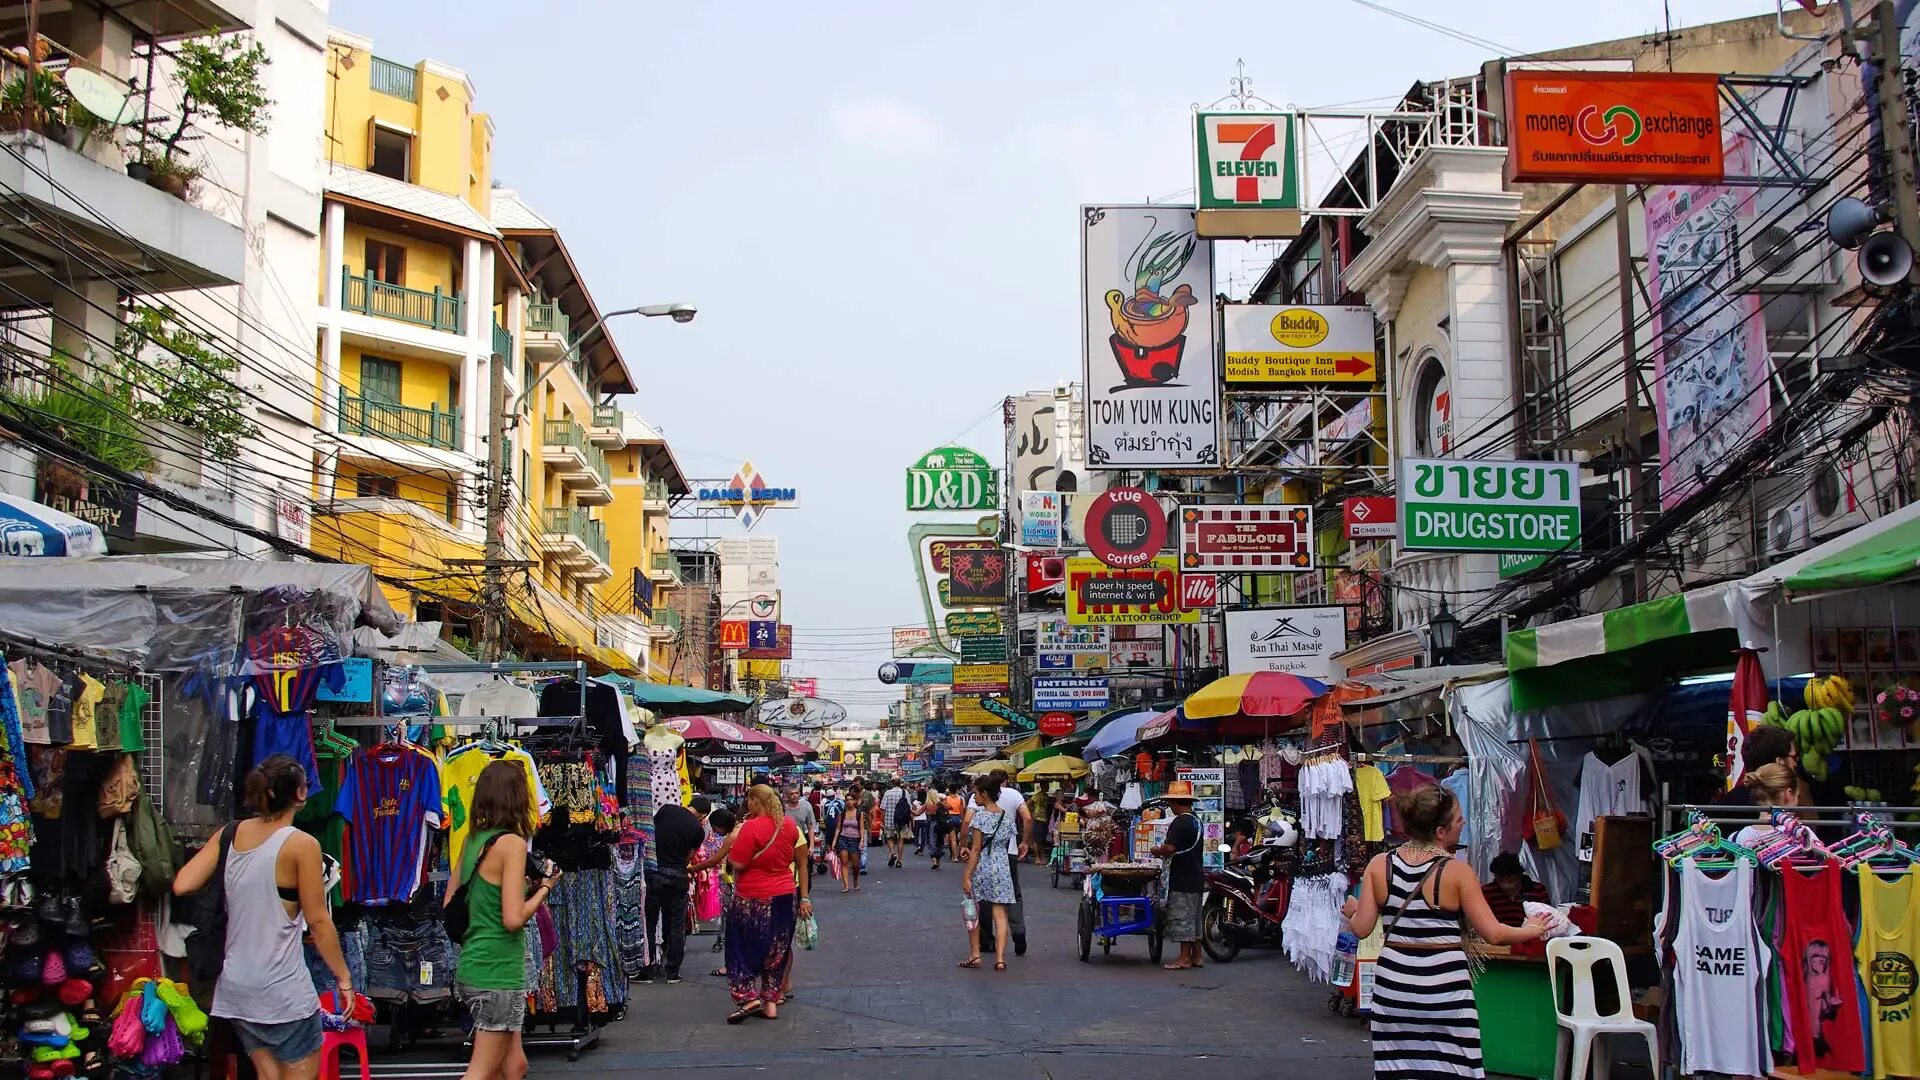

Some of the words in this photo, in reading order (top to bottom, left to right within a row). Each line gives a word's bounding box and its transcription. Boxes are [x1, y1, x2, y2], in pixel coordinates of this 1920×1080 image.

[1526, 112, 1575, 137] money
[1645, 111, 1714, 140] exchange
[1216, 123, 1276, 203] 7
[1280, 315, 1320, 333] Buddy
[1227, 357, 1260, 371] Buddy
[1265, 356, 1311, 372] Boutique
[1315, 356, 1334, 370] Inn
[1227, 367, 1261, 381] Modish
[1268, 367, 1307, 383] Bangkok
[1311, 367, 1335, 381] Hotel
[1093, 399, 1125, 425] TOM
[1130, 399, 1163, 425] YUM
[1169, 399, 1213, 425] KUNG
[1114, 430, 1193, 460] ต้มยำกุ้ง
[985, 471, 997, 506] INN
[1414, 463, 1570, 501] ขายยา
[751, 488, 796, 501] DERM
[909, 470, 982, 510] D&D
[1109, 490, 1143, 503] true
[1235, 524, 1257, 533] THE
[1415, 511, 1571, 541] DRUGSTORE
[1206, 534, 1286, 544] FABULOUS
[1107, 552, 1148, 565] coffee
[1089, 582, 1114, 593] super
[1115, 581, 1125, 591] hi
[1126, 582, 1154, 593] speed
[1185, 579, 1215, 605] illy
[1089, 590, 1124, 600] internet
[1125, 591, 1134, 600] &
[1136, 590, 1147, 600] wi
[1149, 590, 1155, 600] fi
[1087, 615, 1107, 623] EAK
[1108, 614, 1147, 623] TATTOO
[1148, 613, 1182, 622] GROUP
[756, 630, 769, 640] 24
[1249, 644, 1267, 653] Ban
[1267, 642, 1289, 653] Thai
[1292, 640, 1323, 654] Masaje
[1269, 661, 1307, 672] Bangkok
[956, 734, 989, 742] INTERNET
[1178, 773, 1221, 781] EXCHANGE
